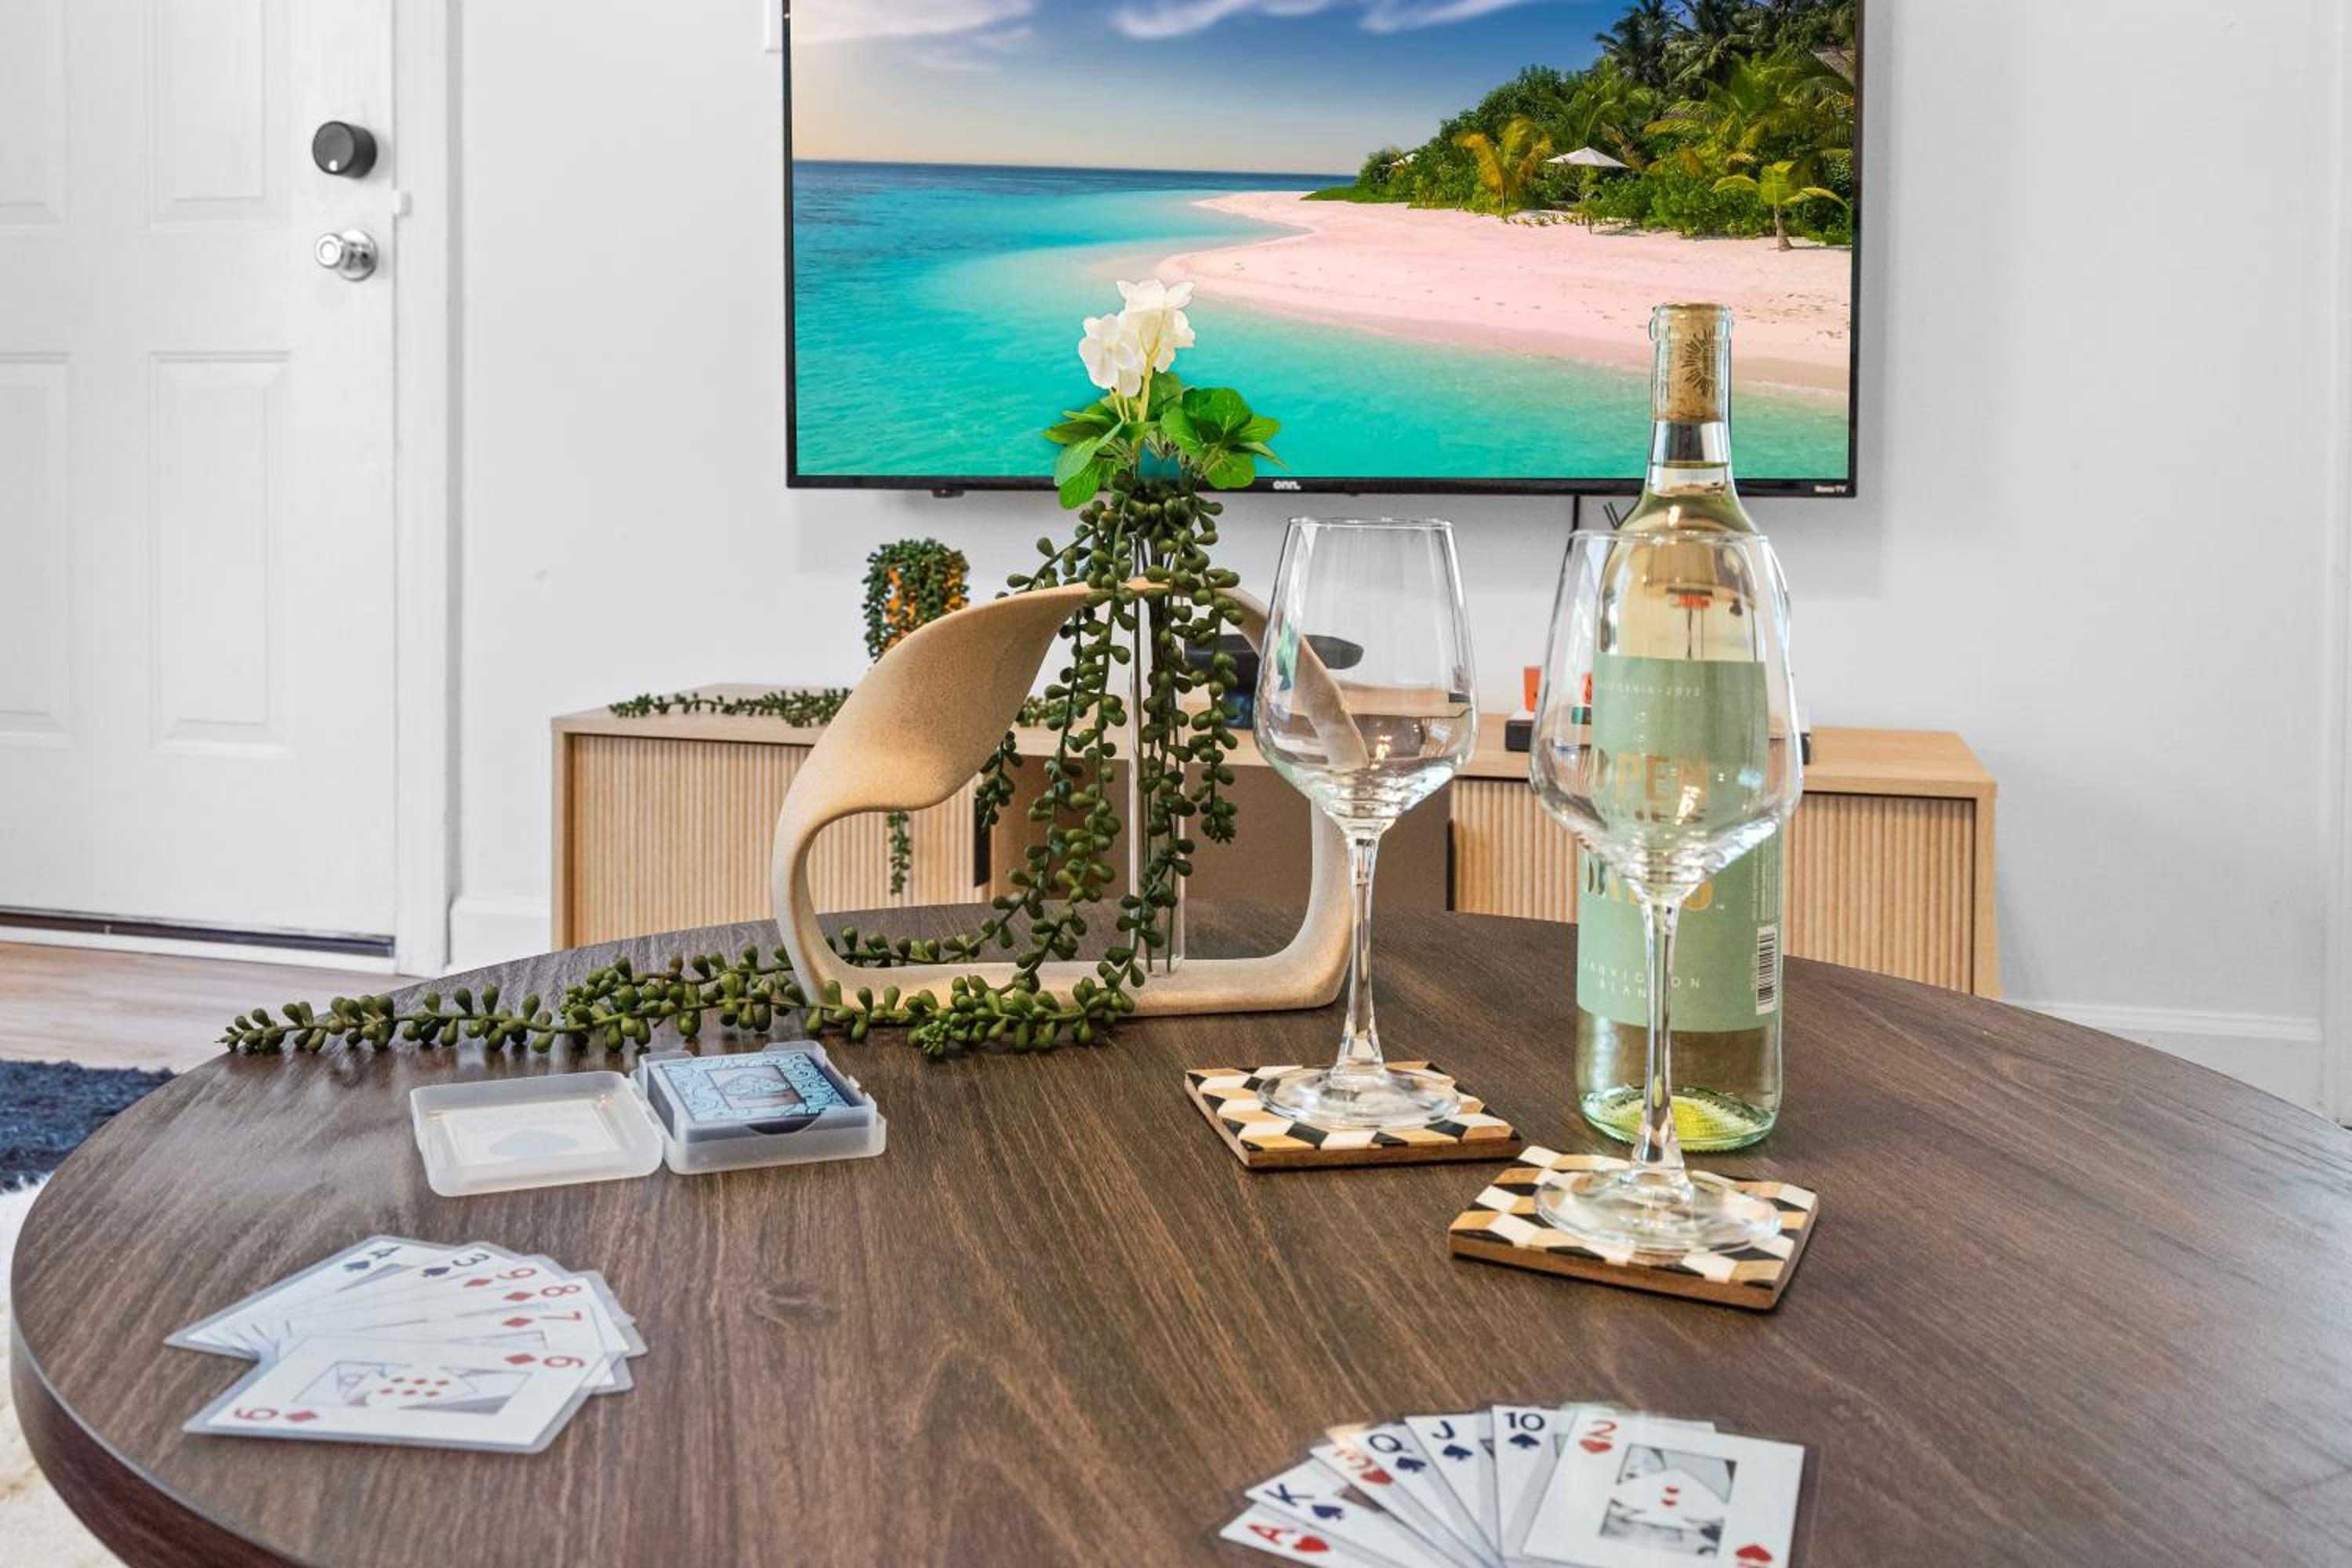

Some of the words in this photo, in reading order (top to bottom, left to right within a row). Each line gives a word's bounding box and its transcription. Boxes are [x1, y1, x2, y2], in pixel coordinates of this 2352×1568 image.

[1599, 978, 1647, 998] BLAN
[452, 1254, 490, 1267] 3
[540, 1284, 582, 1297] 8
[539, 1311, 582, 1321] 7
[1432, 1420, 1455, 1439] J
[1504, 1412, 1545, 1432] 10
[1588, 1420, 1617, 1439] 2
[1368, 1433, 1412, 1453] Q
[1265, 1483, 1315, 1507] K
[1247, 1523, 1296, 1545] A
